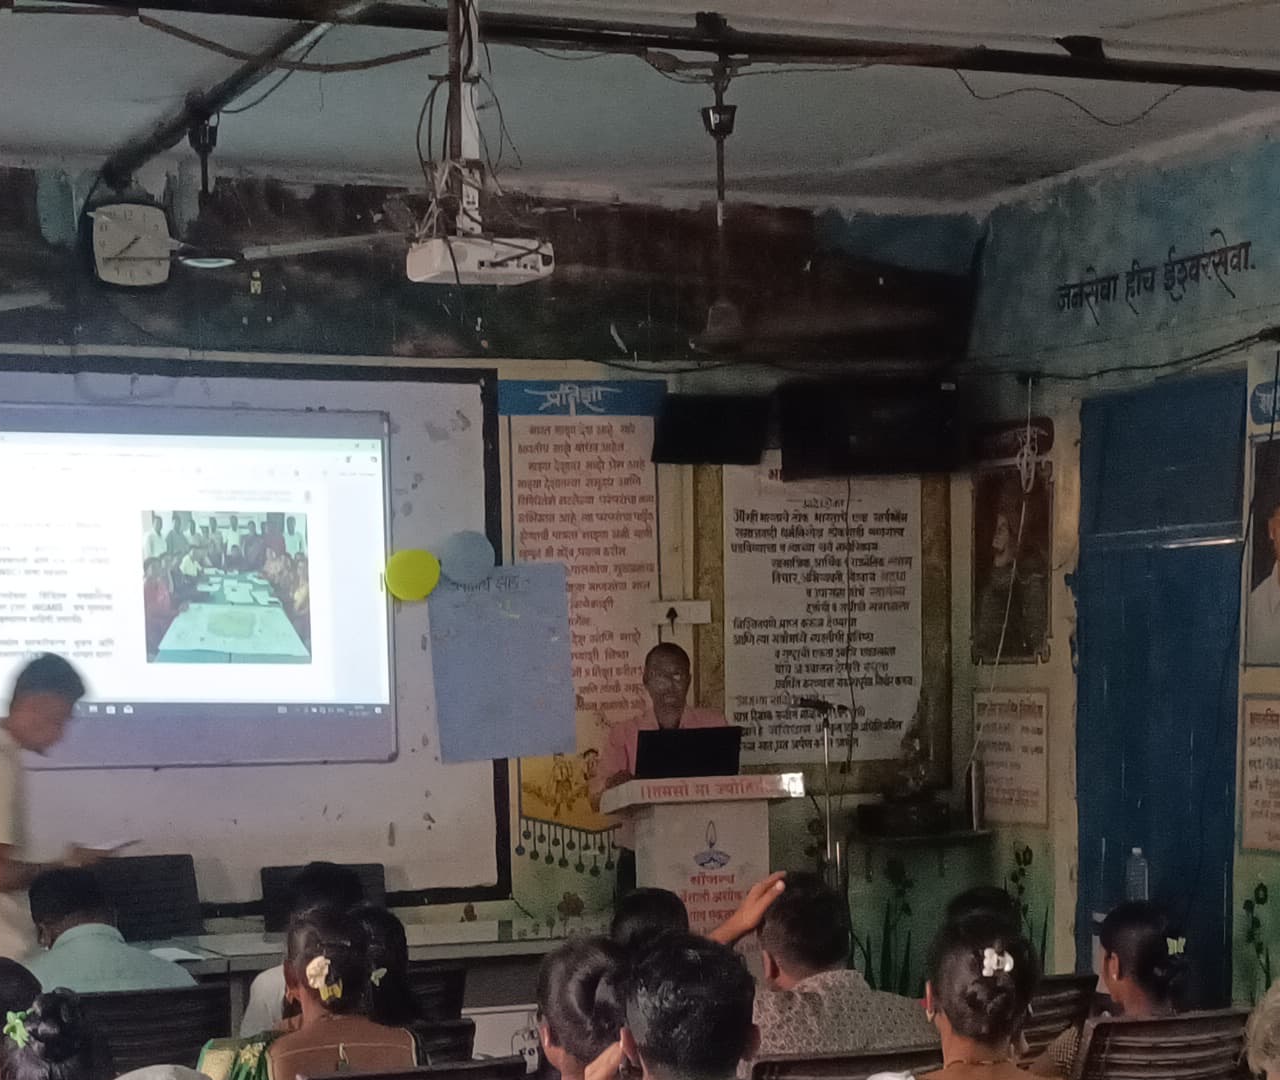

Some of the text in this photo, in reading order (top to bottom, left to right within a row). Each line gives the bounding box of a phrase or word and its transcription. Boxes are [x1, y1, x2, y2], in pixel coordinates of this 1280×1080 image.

[1056, 265, 1119, 326] जनसेवा
[1125, 259, 1157, 316] हीच
[524, 383, 622, 413] प्रतिज्ञा
